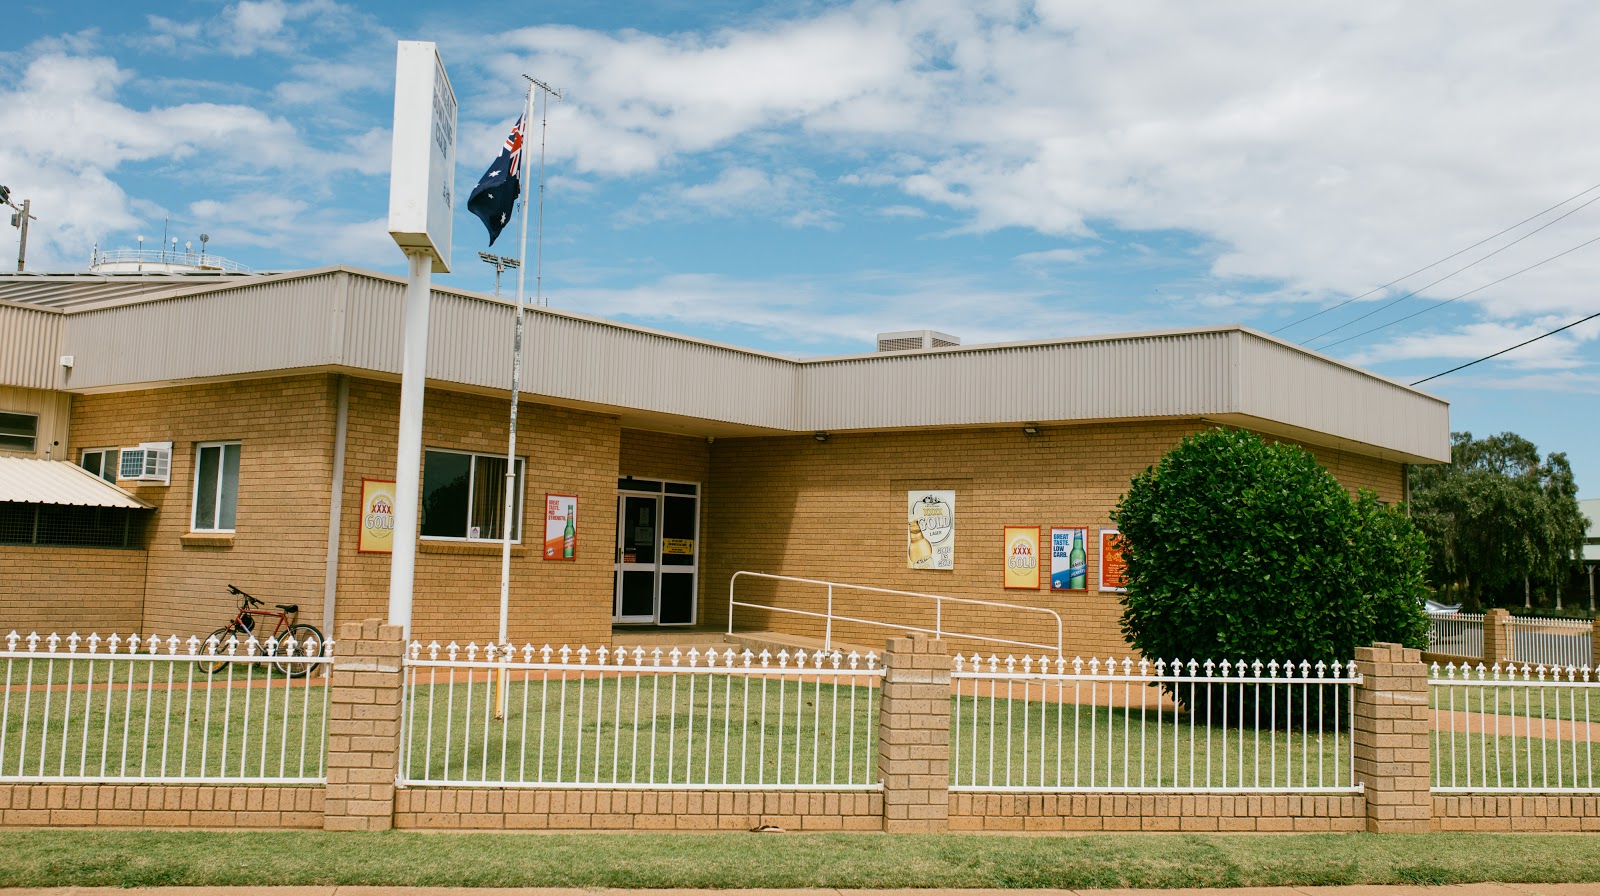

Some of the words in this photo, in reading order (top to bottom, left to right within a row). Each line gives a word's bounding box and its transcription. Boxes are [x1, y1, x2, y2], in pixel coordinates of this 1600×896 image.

[371, 504, 392, 514] XXXX
[365, 514, 395, 530] GOLD
[919, 516, 951, 531] GOLD
[1012, 547, 1032, 555] XXXX
[1008, 555, 1037, 569] GOLD
